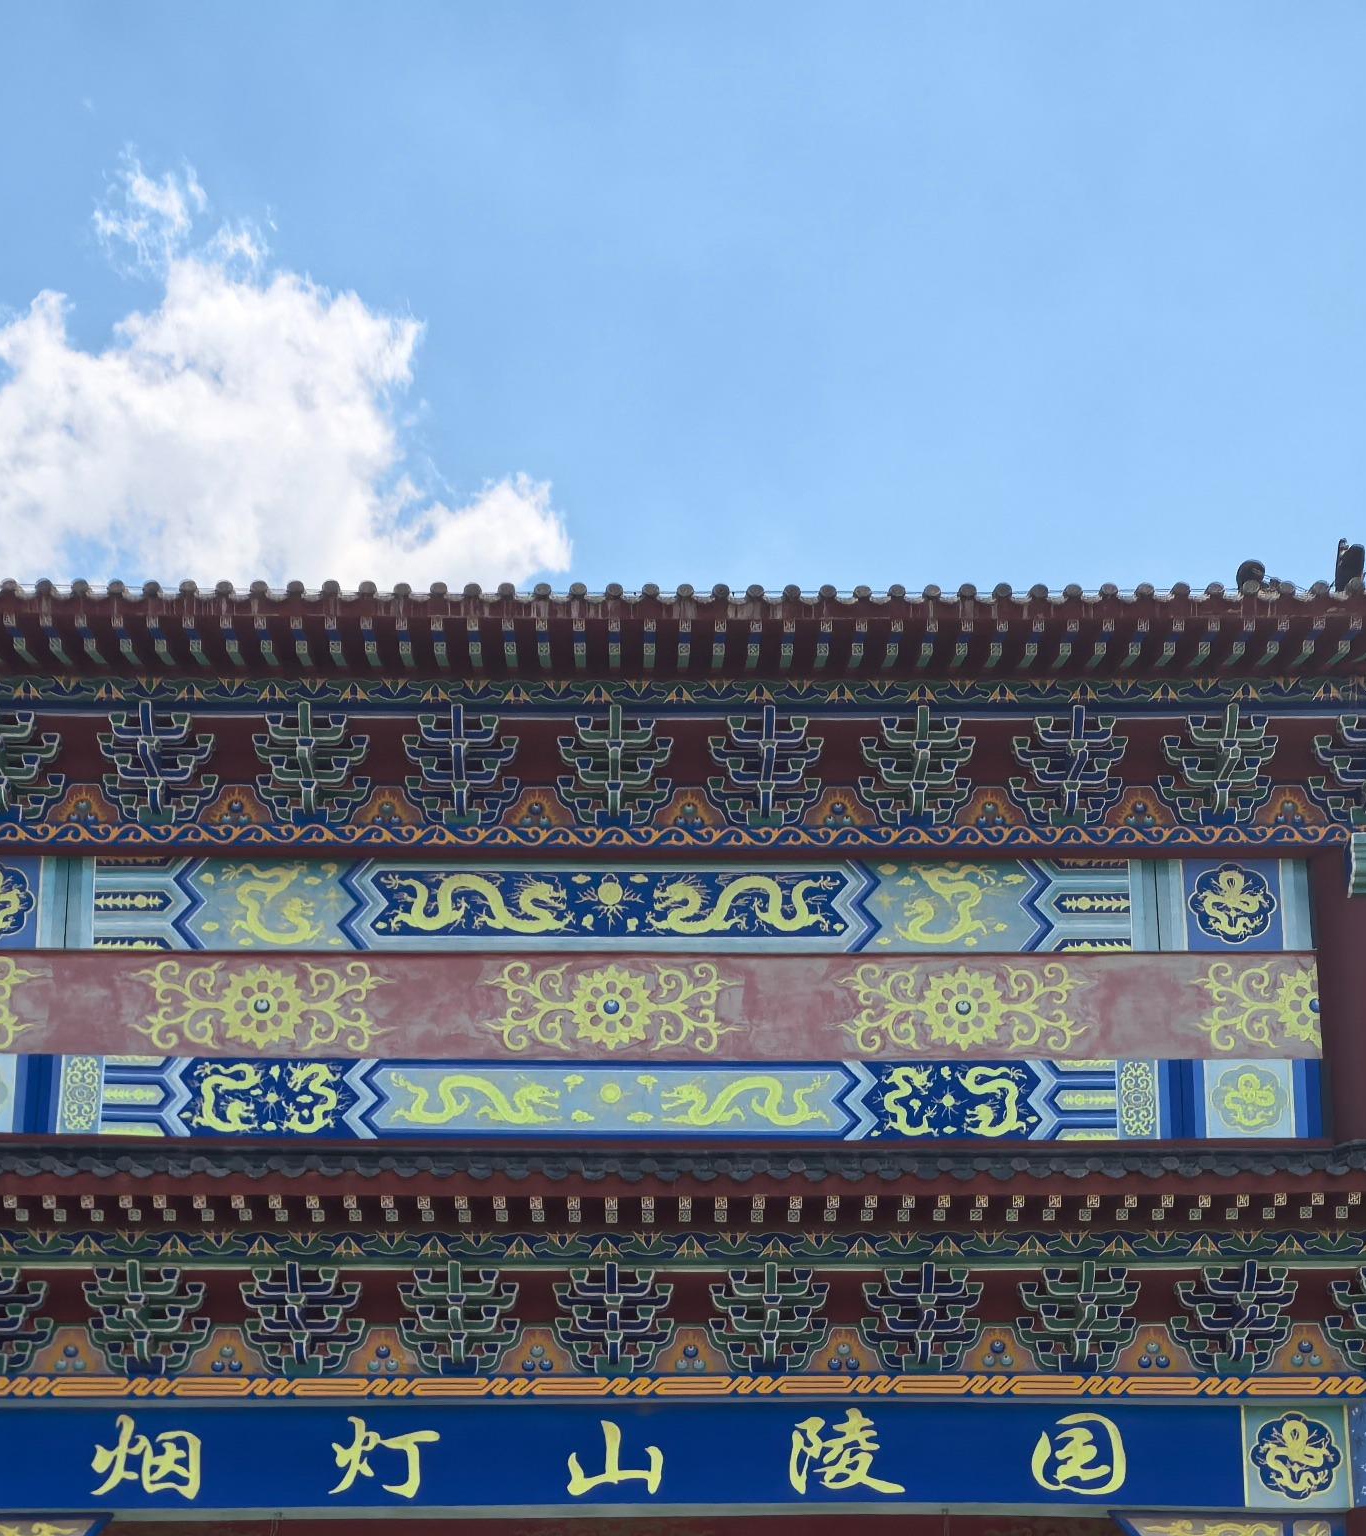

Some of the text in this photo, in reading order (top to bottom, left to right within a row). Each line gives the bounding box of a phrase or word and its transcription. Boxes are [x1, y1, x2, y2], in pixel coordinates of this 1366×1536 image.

[91, 1408, 1126, 1499] 烟灯山陵园
